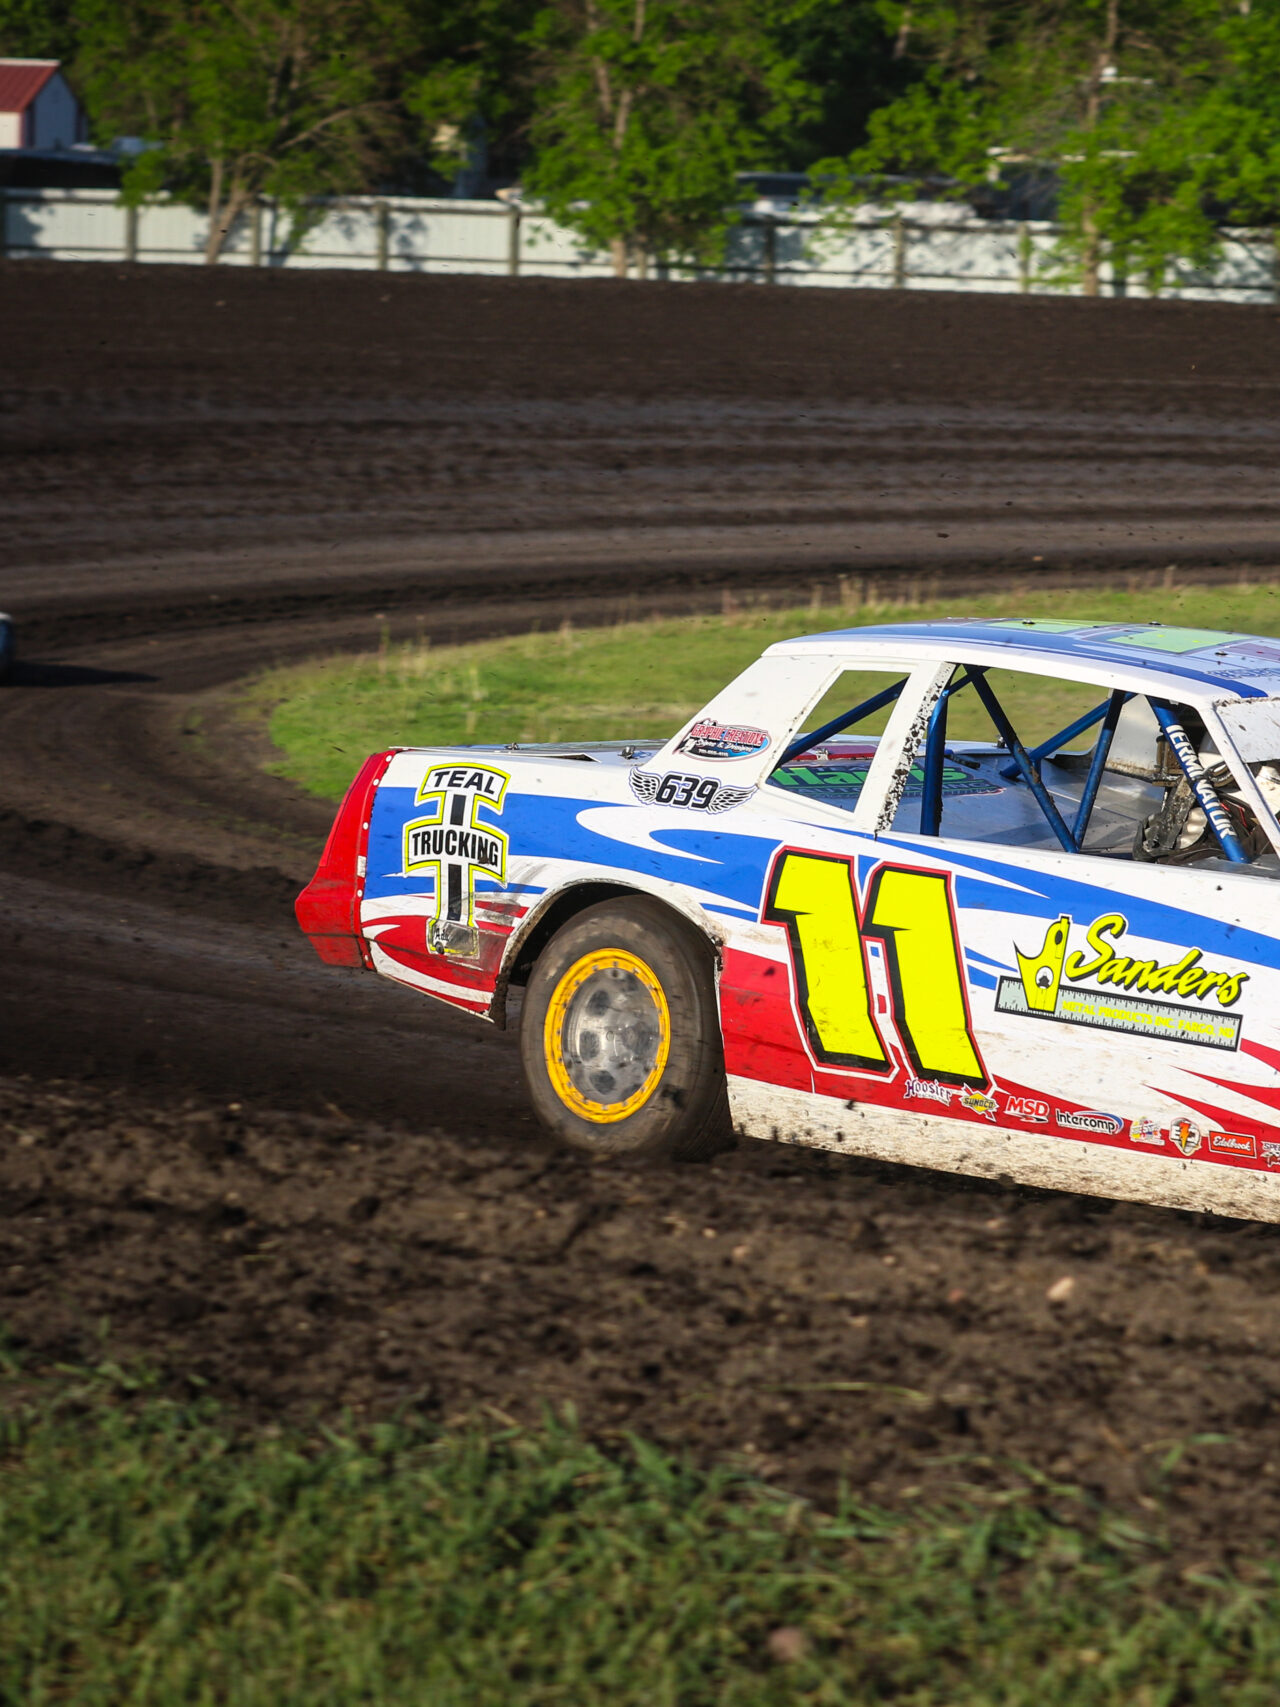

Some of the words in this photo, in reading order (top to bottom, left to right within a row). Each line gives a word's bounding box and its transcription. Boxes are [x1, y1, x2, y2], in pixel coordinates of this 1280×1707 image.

[434, 770, 495, 794] TEAL
[656, 774, 719, 809] 639
[412, 829, 499, 867] TRUCKING
[763, 850, 990, 1089] 11
[1064, 914, 1250, 1007] Sanders
[1062, 1000, 1096, 1016] METAL
[1097, 1006, 1153, 1024] PRODUCTS
[1218, 1026, 1236, 1039] ND
[963, 1096, 995, 1110] SUNOCO
[1006, 1096, 1049, 1117] MSD
[1055, 1109, 1116, 1133] Intercomp
[1212, 1135, 1251, 1152] Edelbrock
